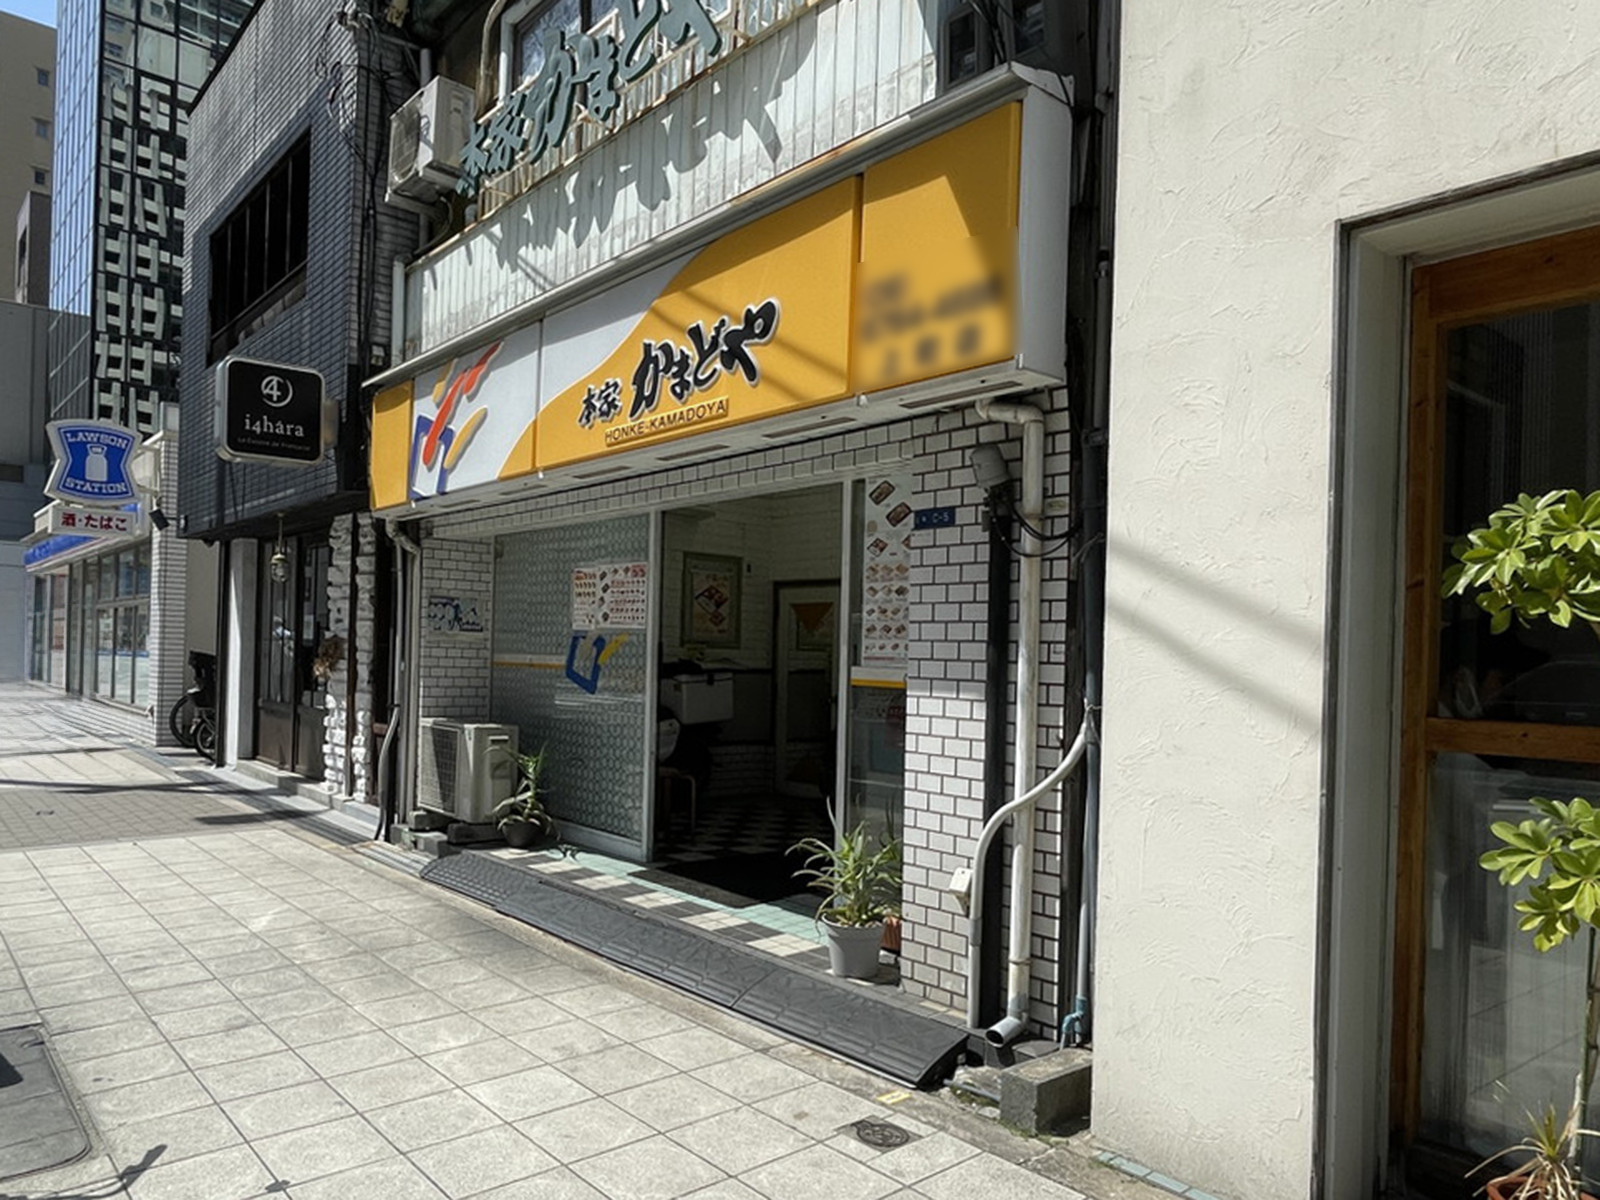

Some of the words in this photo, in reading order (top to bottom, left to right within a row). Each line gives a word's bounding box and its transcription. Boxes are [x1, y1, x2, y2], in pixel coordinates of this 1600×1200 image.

[605, 400, 727, 443] HONKE-KAMADOYA
[66, 431, 129, 451] LAWSON
[64, 476, 128, 494] STATION
